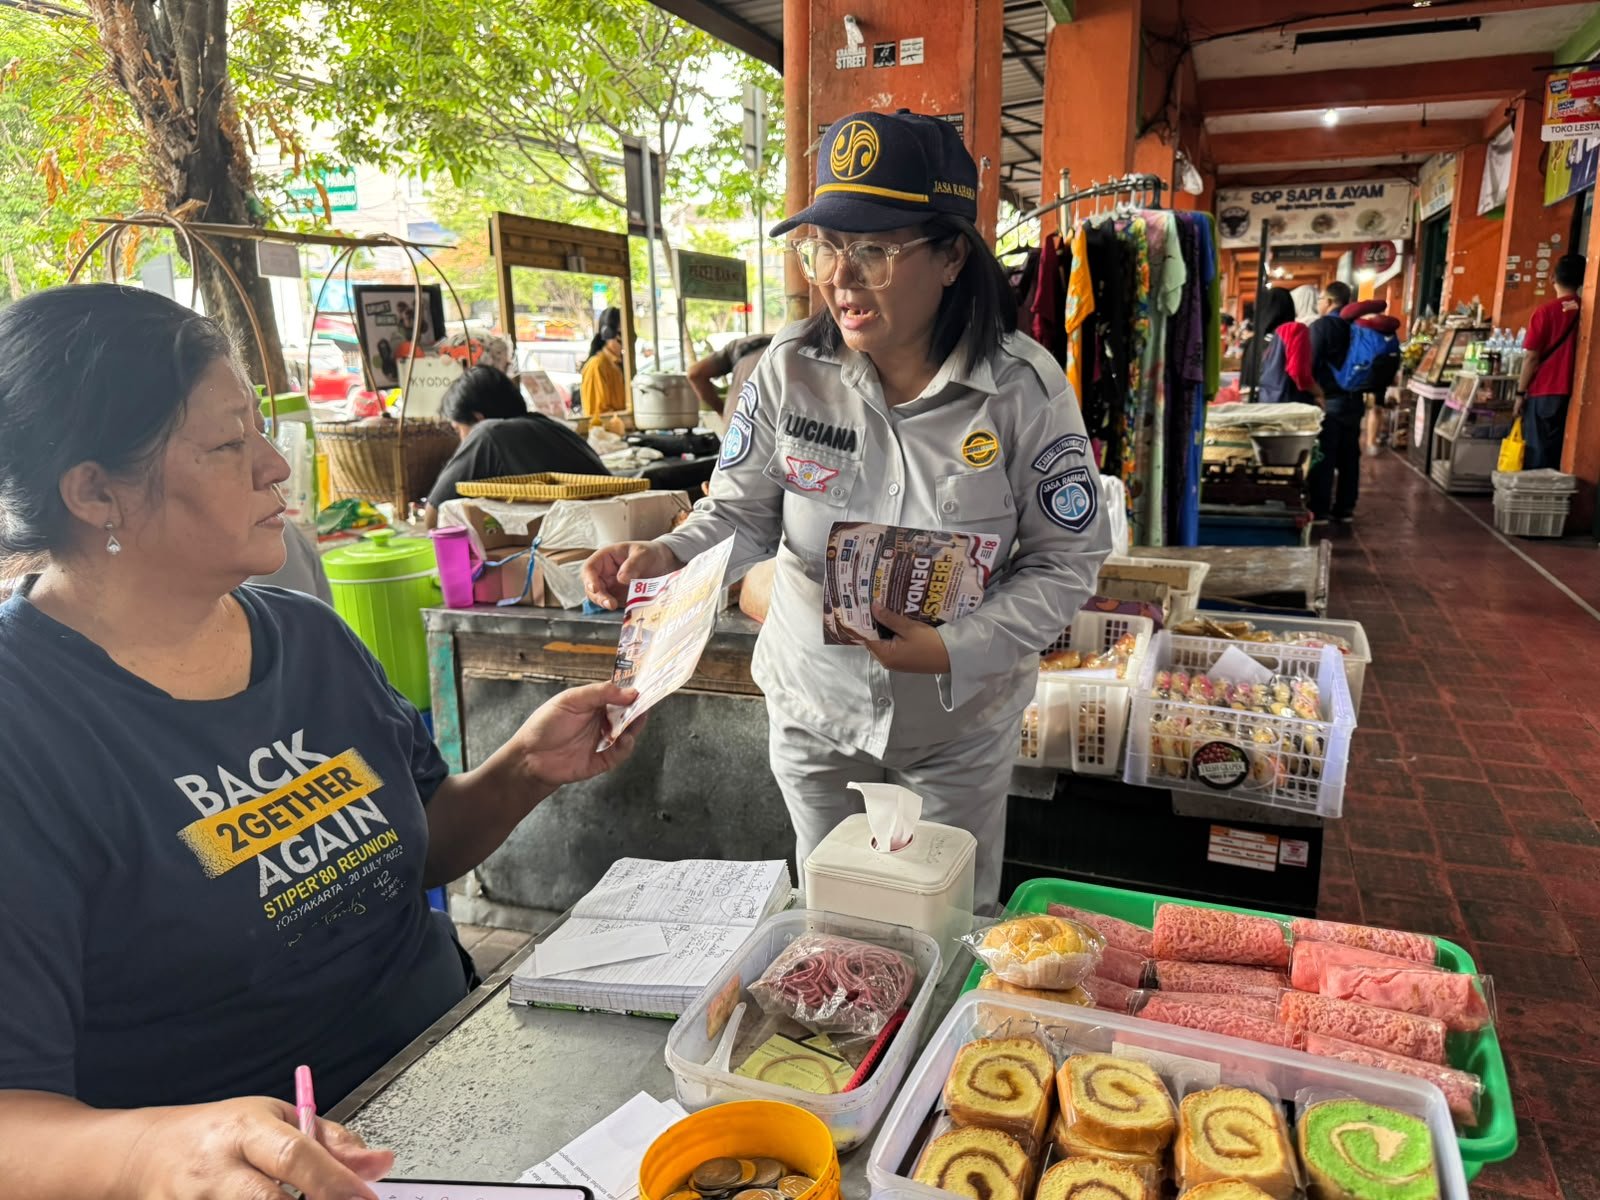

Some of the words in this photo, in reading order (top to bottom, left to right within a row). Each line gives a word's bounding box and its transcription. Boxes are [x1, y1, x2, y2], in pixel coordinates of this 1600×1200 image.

[836, 55, 867, 69] STREET
[1551, 124, 1573, 133] TOKO
[1574, 122, 1600, 131] LESTA
[933, 180, 952, 193] JASA
[1251, 190, 1282, 204] SOP
[1286, 188, 1322, 202] SAPI
[1325, 187, 1337, 200] &
[1340, 184, 1385, 199] AYAM
[784, 413, 858, 453] LUCIANA
[1043, 481, 1061, 493] JASA
[634, 581, 647, 594] 81
[904, 557, 931, 614] DENDA
[173, 728, 331, 818] BACK
[215, 766, 364, 853] 2GETHER
[256, 794, 390, 898] AGAIN
[336, 828, 399, 874] REUNION
[373, 869, 391, 889] 42
[275, 882, 344, 932] YOGYAKARTA
[348, 871, 360, 885] 20
[361, 857, 382, 877] JULY
